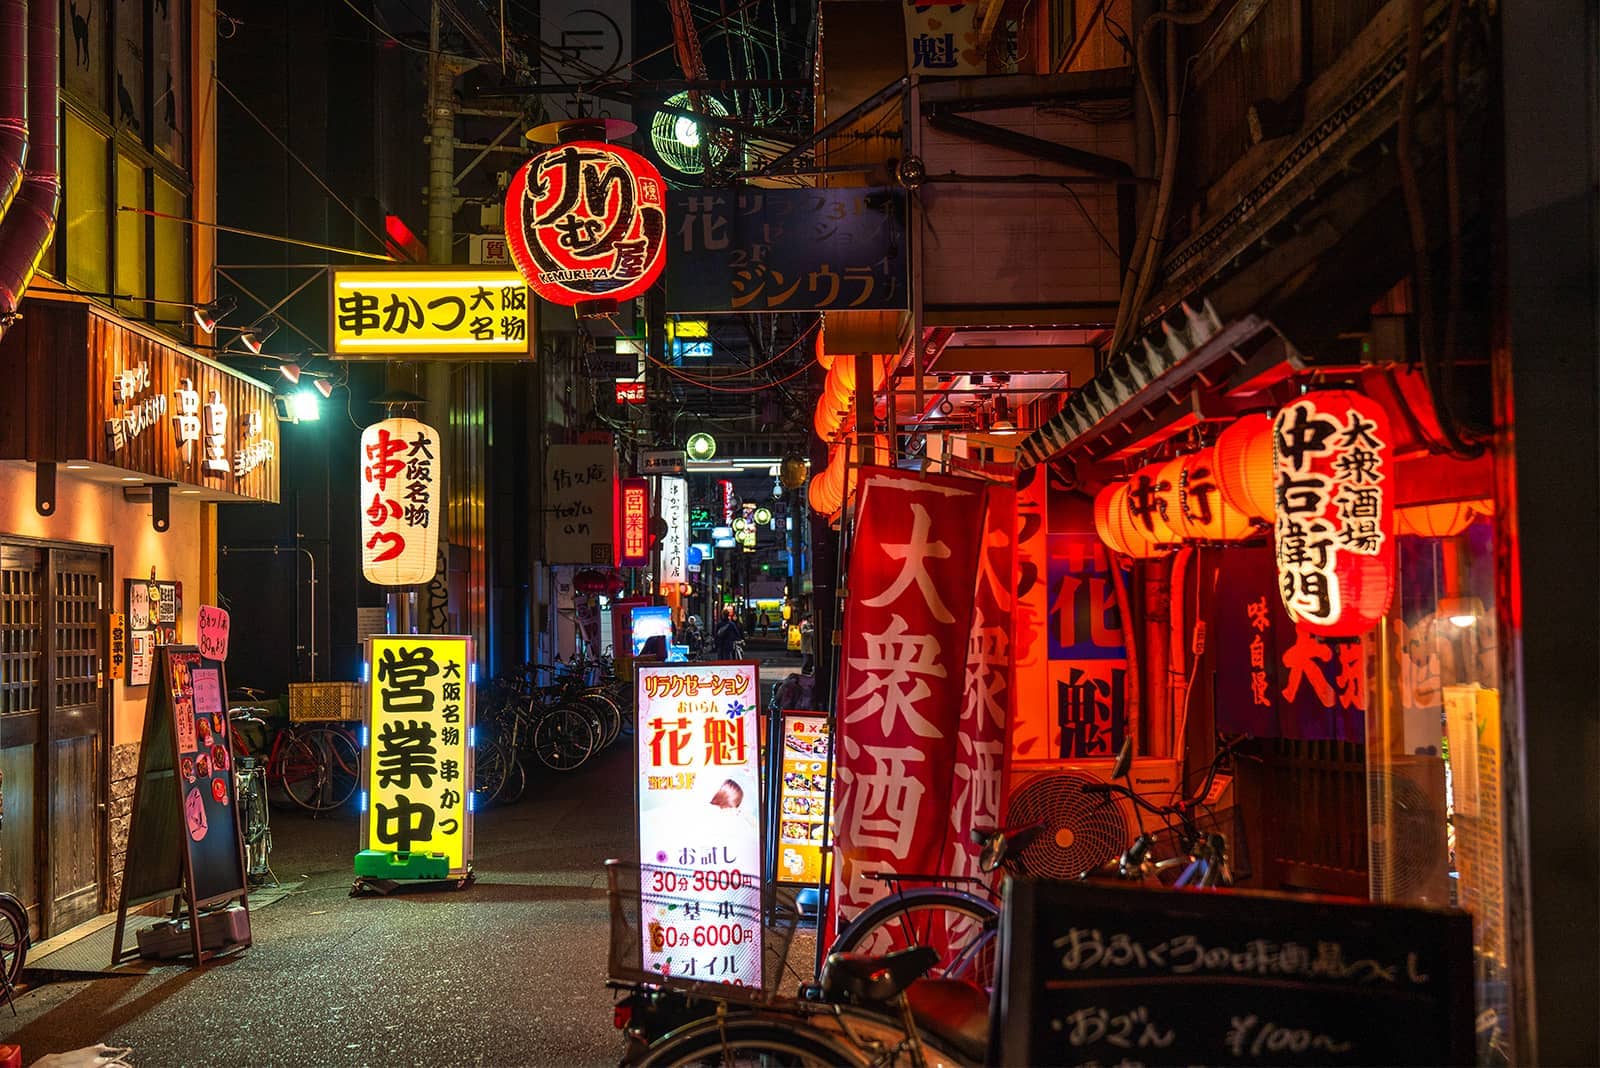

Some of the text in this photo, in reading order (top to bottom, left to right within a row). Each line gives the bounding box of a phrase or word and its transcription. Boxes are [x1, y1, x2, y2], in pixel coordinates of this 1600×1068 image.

[487, 241, 504, 259] 質
[539, 268, 609, 284] KEMURI-YA
[731, 263, 875, 308] ジンウラ
[338, 291, 466, 336] 串かつ
[470, 286, 526, 312] 大阪
[470, 317, 525, 341] 名物
[365, 429, 408, 562] 串かつ
[403, 432, 434, 528] 大阪名物
[1336, 413, 1381, 551] 大衆酒場
[626, 489, 645, 555] 営業中
[645, 674, 751, 697] リラクゼーション
[677, 701, 719, 713] おいらん
[376, 646, 440, 860] 営業中
[439, 660, 461, 836] 大阪名物 串かつ
[648, 716, 748, 767] 花魁
[681, 955, 739, 976] オイル
